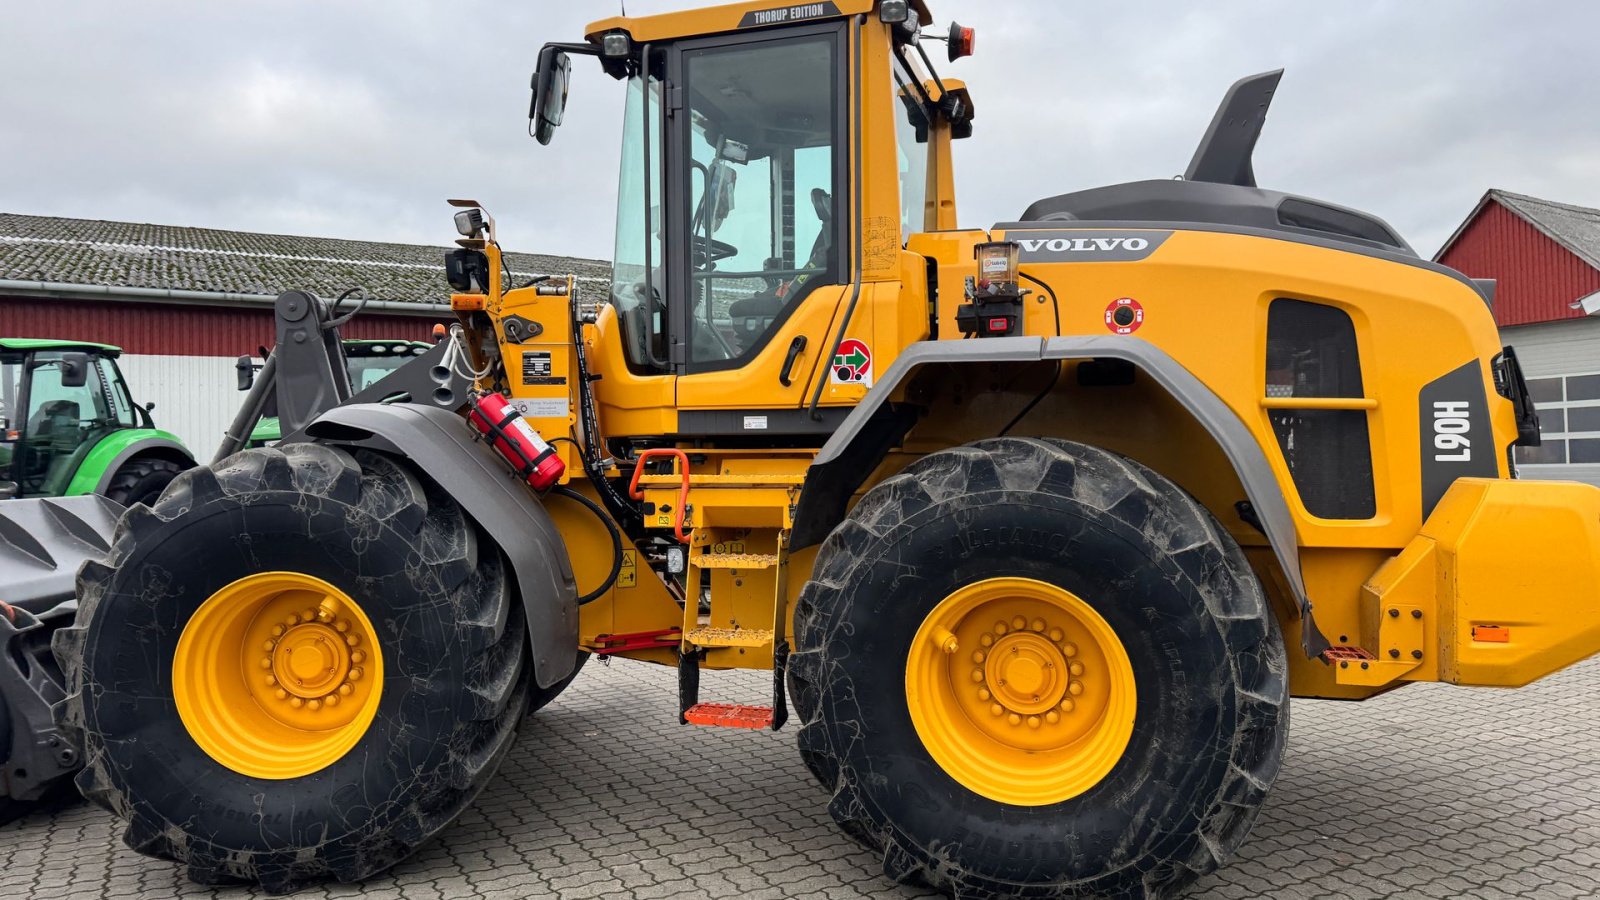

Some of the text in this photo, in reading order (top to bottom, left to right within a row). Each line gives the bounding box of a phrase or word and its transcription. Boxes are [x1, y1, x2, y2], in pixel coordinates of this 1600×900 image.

[754, 4, 824, 24] THORUP EDITION
[1017, 238, 1149, 252] VOLVO
[1433, 401, 1471, 462] L90H
